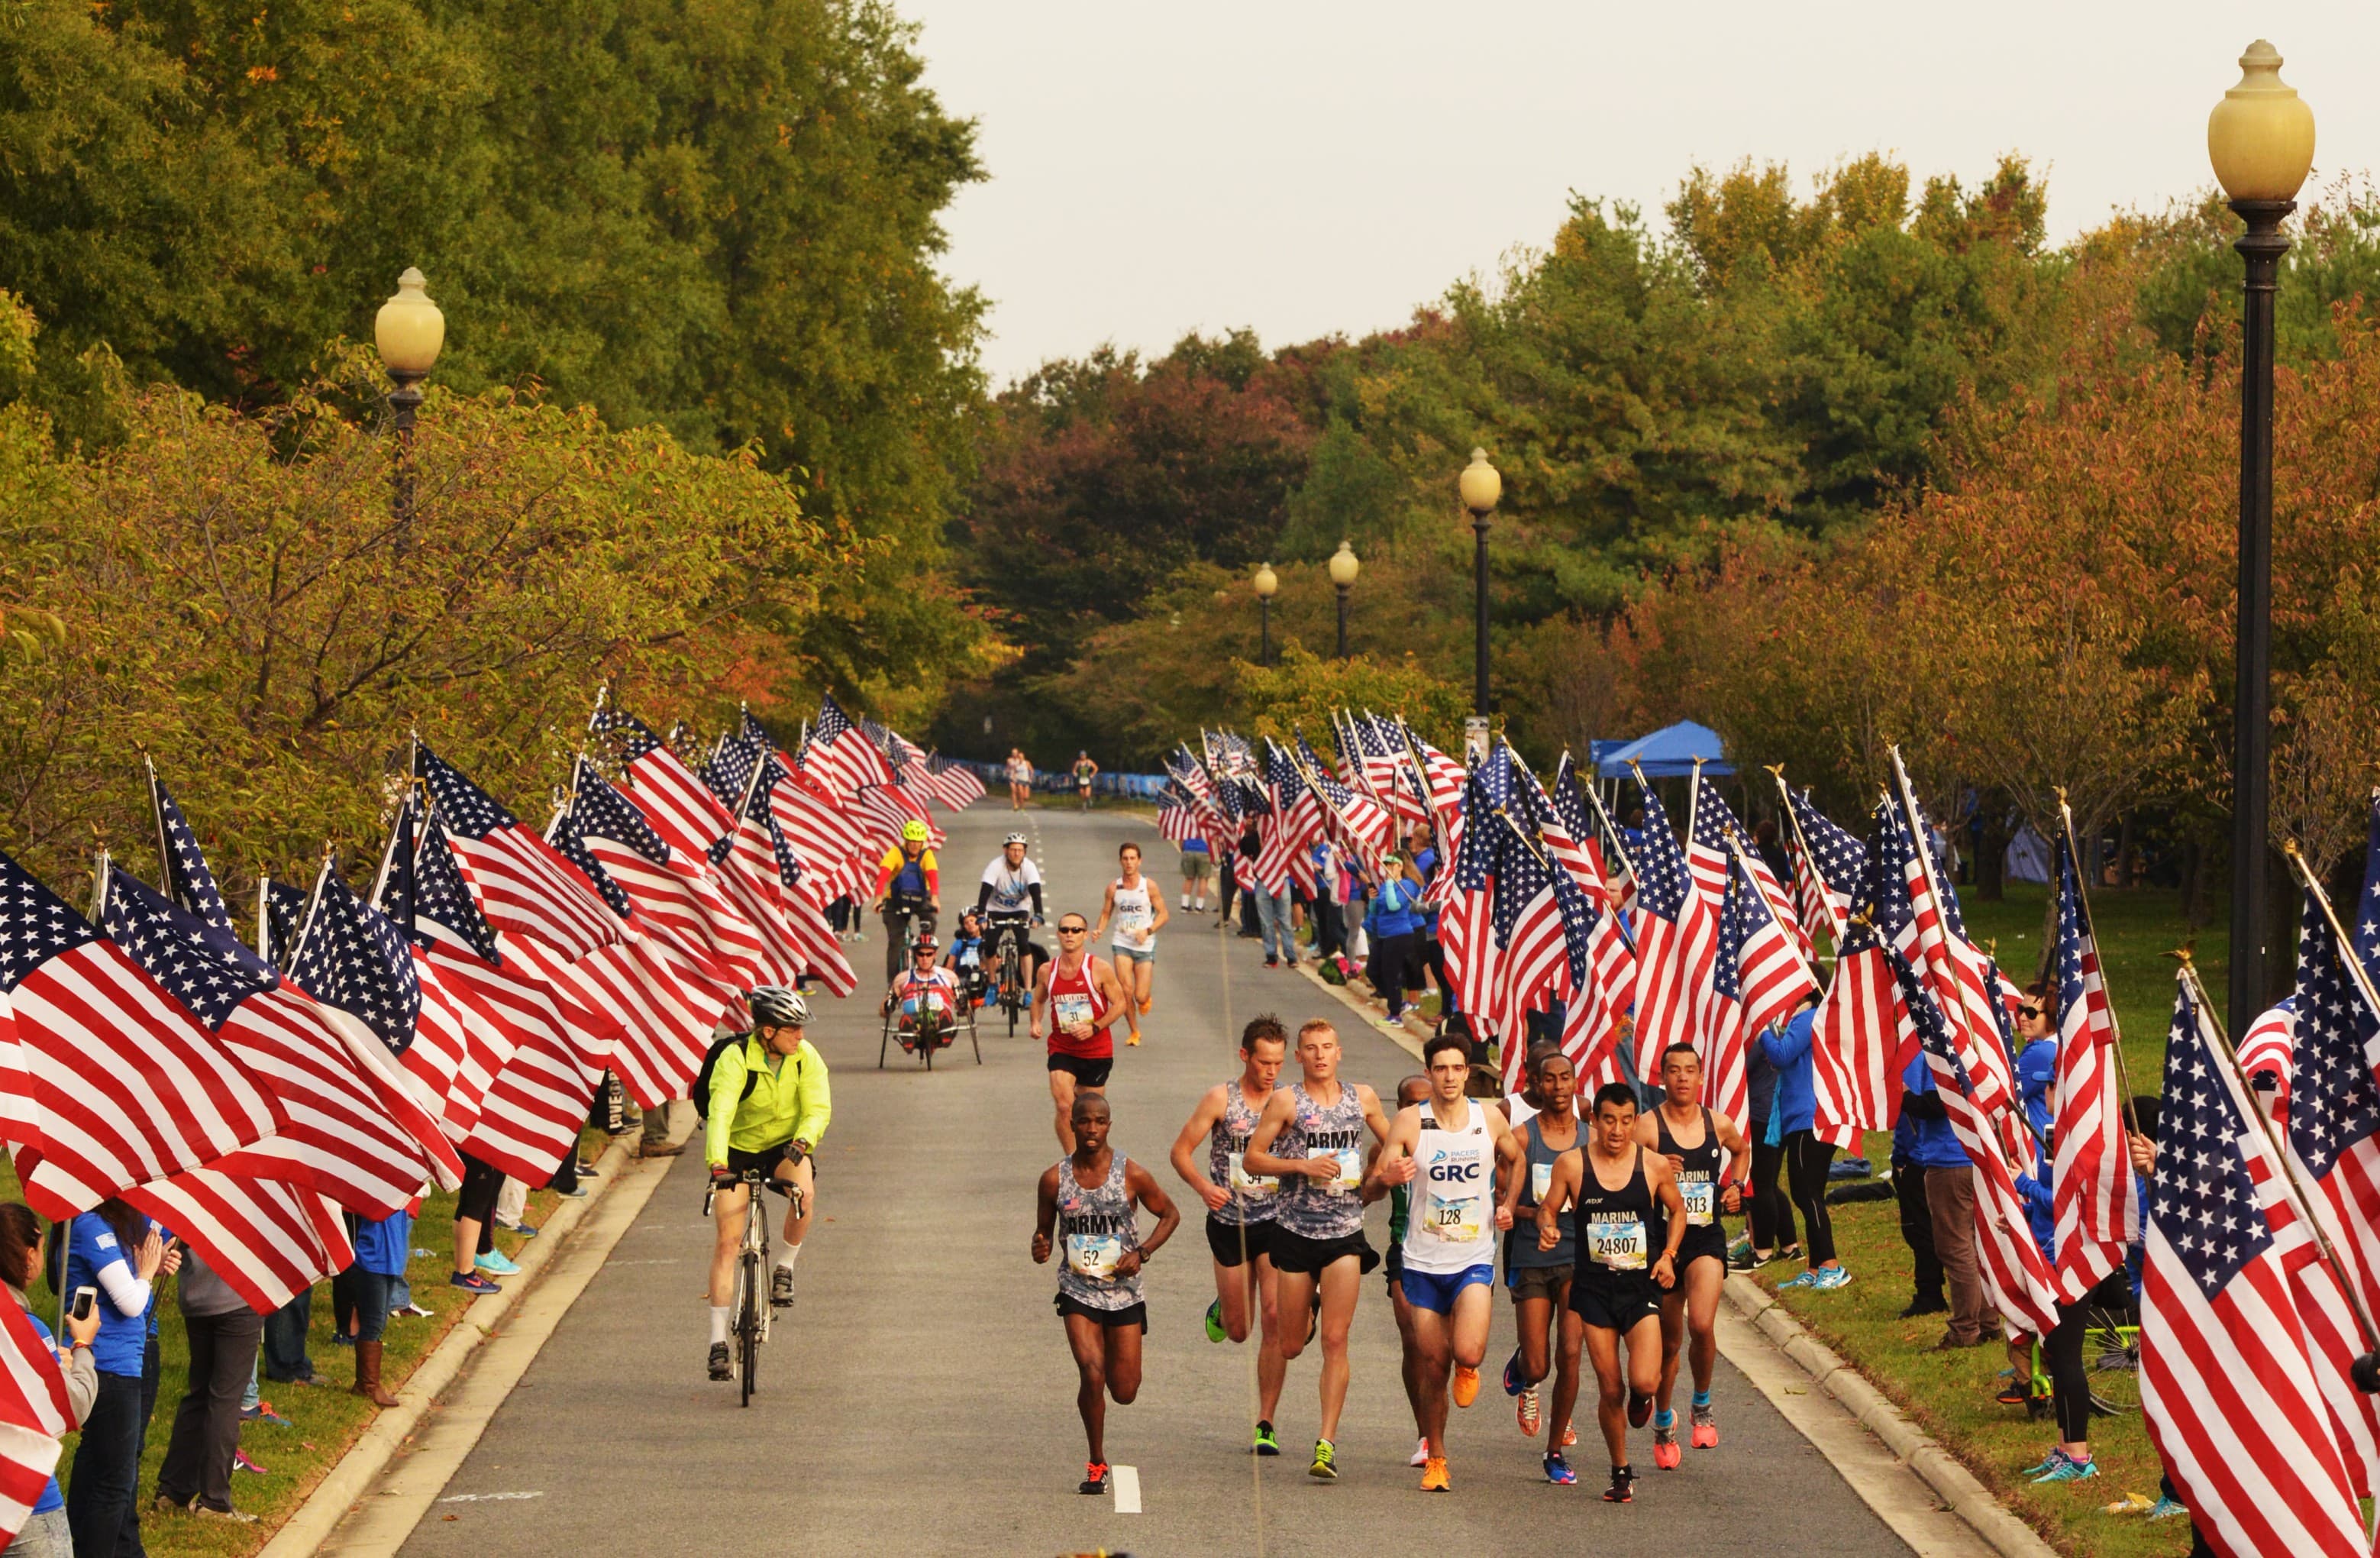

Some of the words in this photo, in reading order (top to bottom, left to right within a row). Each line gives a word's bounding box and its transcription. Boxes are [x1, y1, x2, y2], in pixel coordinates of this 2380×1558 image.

[1120, 905, 1142, 913] GRC
[1069, 1011, 1079, 1023] 31
[609, 1095, 623, 1129] LOVE
[1306, 1130, 1359, 1149] ARMY
[1429, 1162, 1480, 1183] GRC
[1684, 1197, 1707, 1214] 813
[1068, 1214, 1120, 1235] ARMY
[1439, 1208, 1461, 1225] 128
[1591, 1211, 1638, 1223] MARINA
[1597, 1237, 1638, 1255] 24807
[1083, 1249, 1100, 1267] 52
